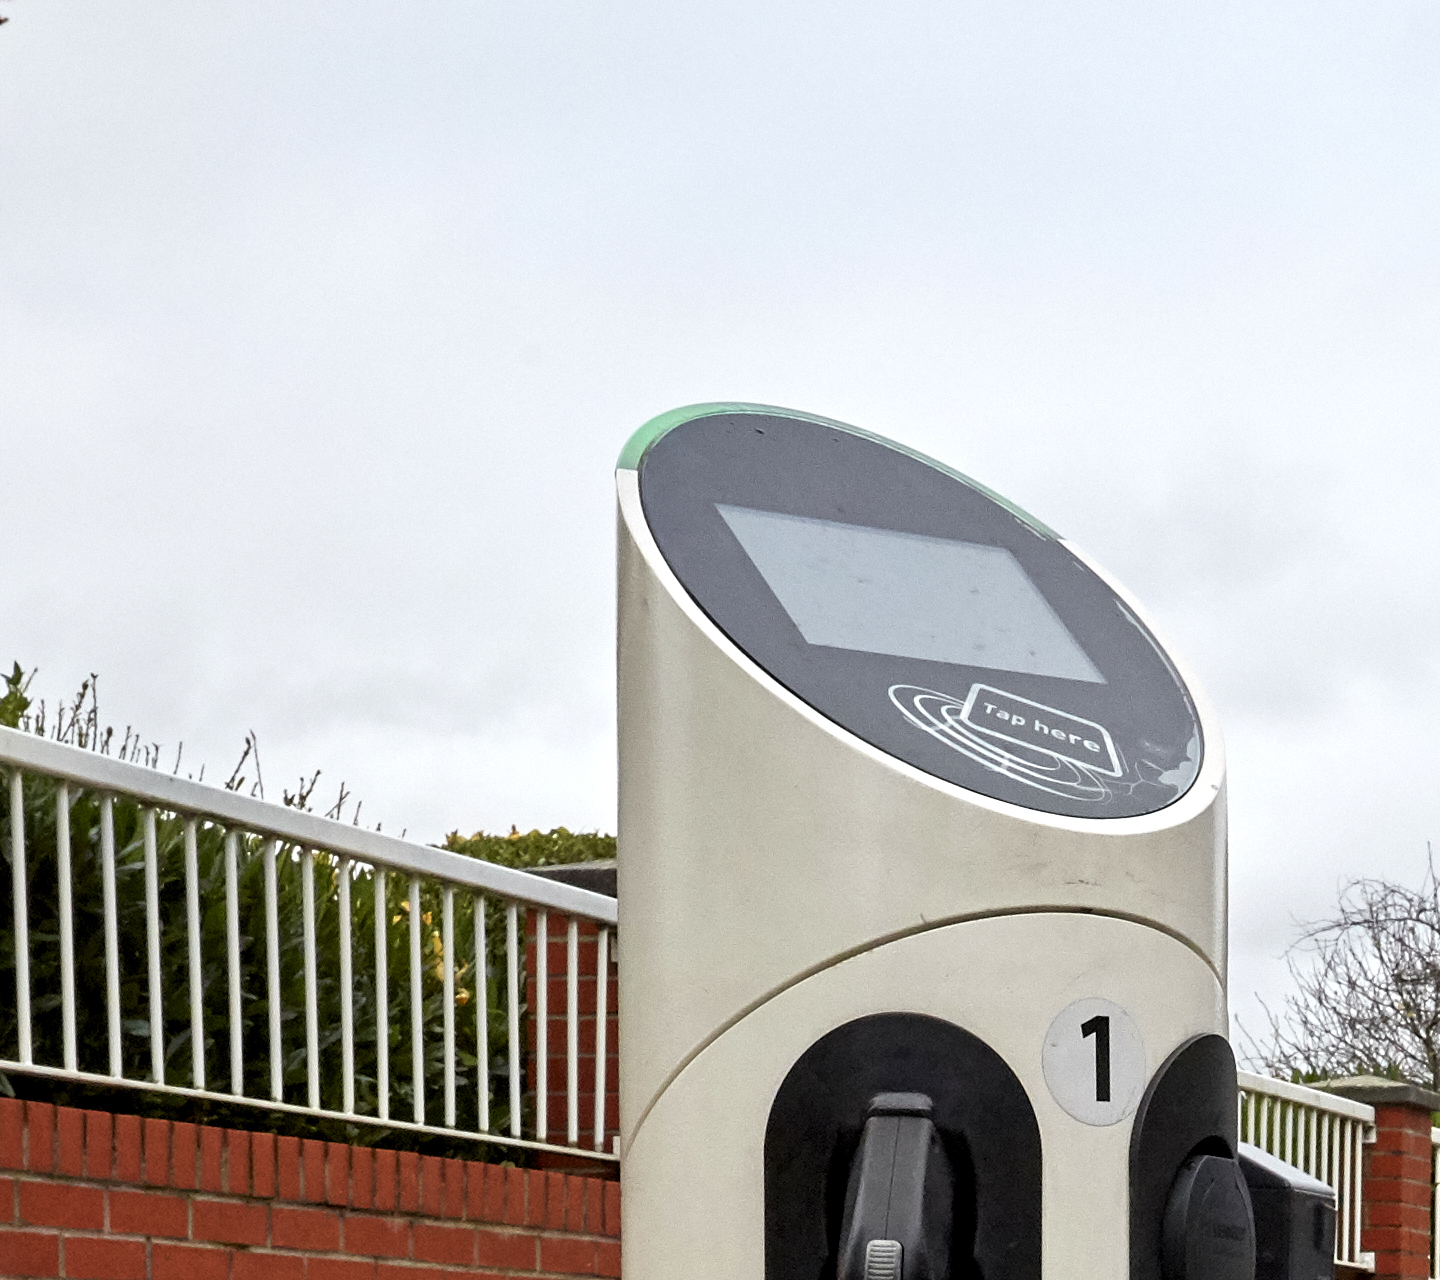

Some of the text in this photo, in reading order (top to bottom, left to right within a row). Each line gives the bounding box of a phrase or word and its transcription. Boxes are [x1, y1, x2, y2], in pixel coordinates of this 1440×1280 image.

[983, 702, 1101, 753] Tap here
[1080, 1015, 1111, 1102] 1
